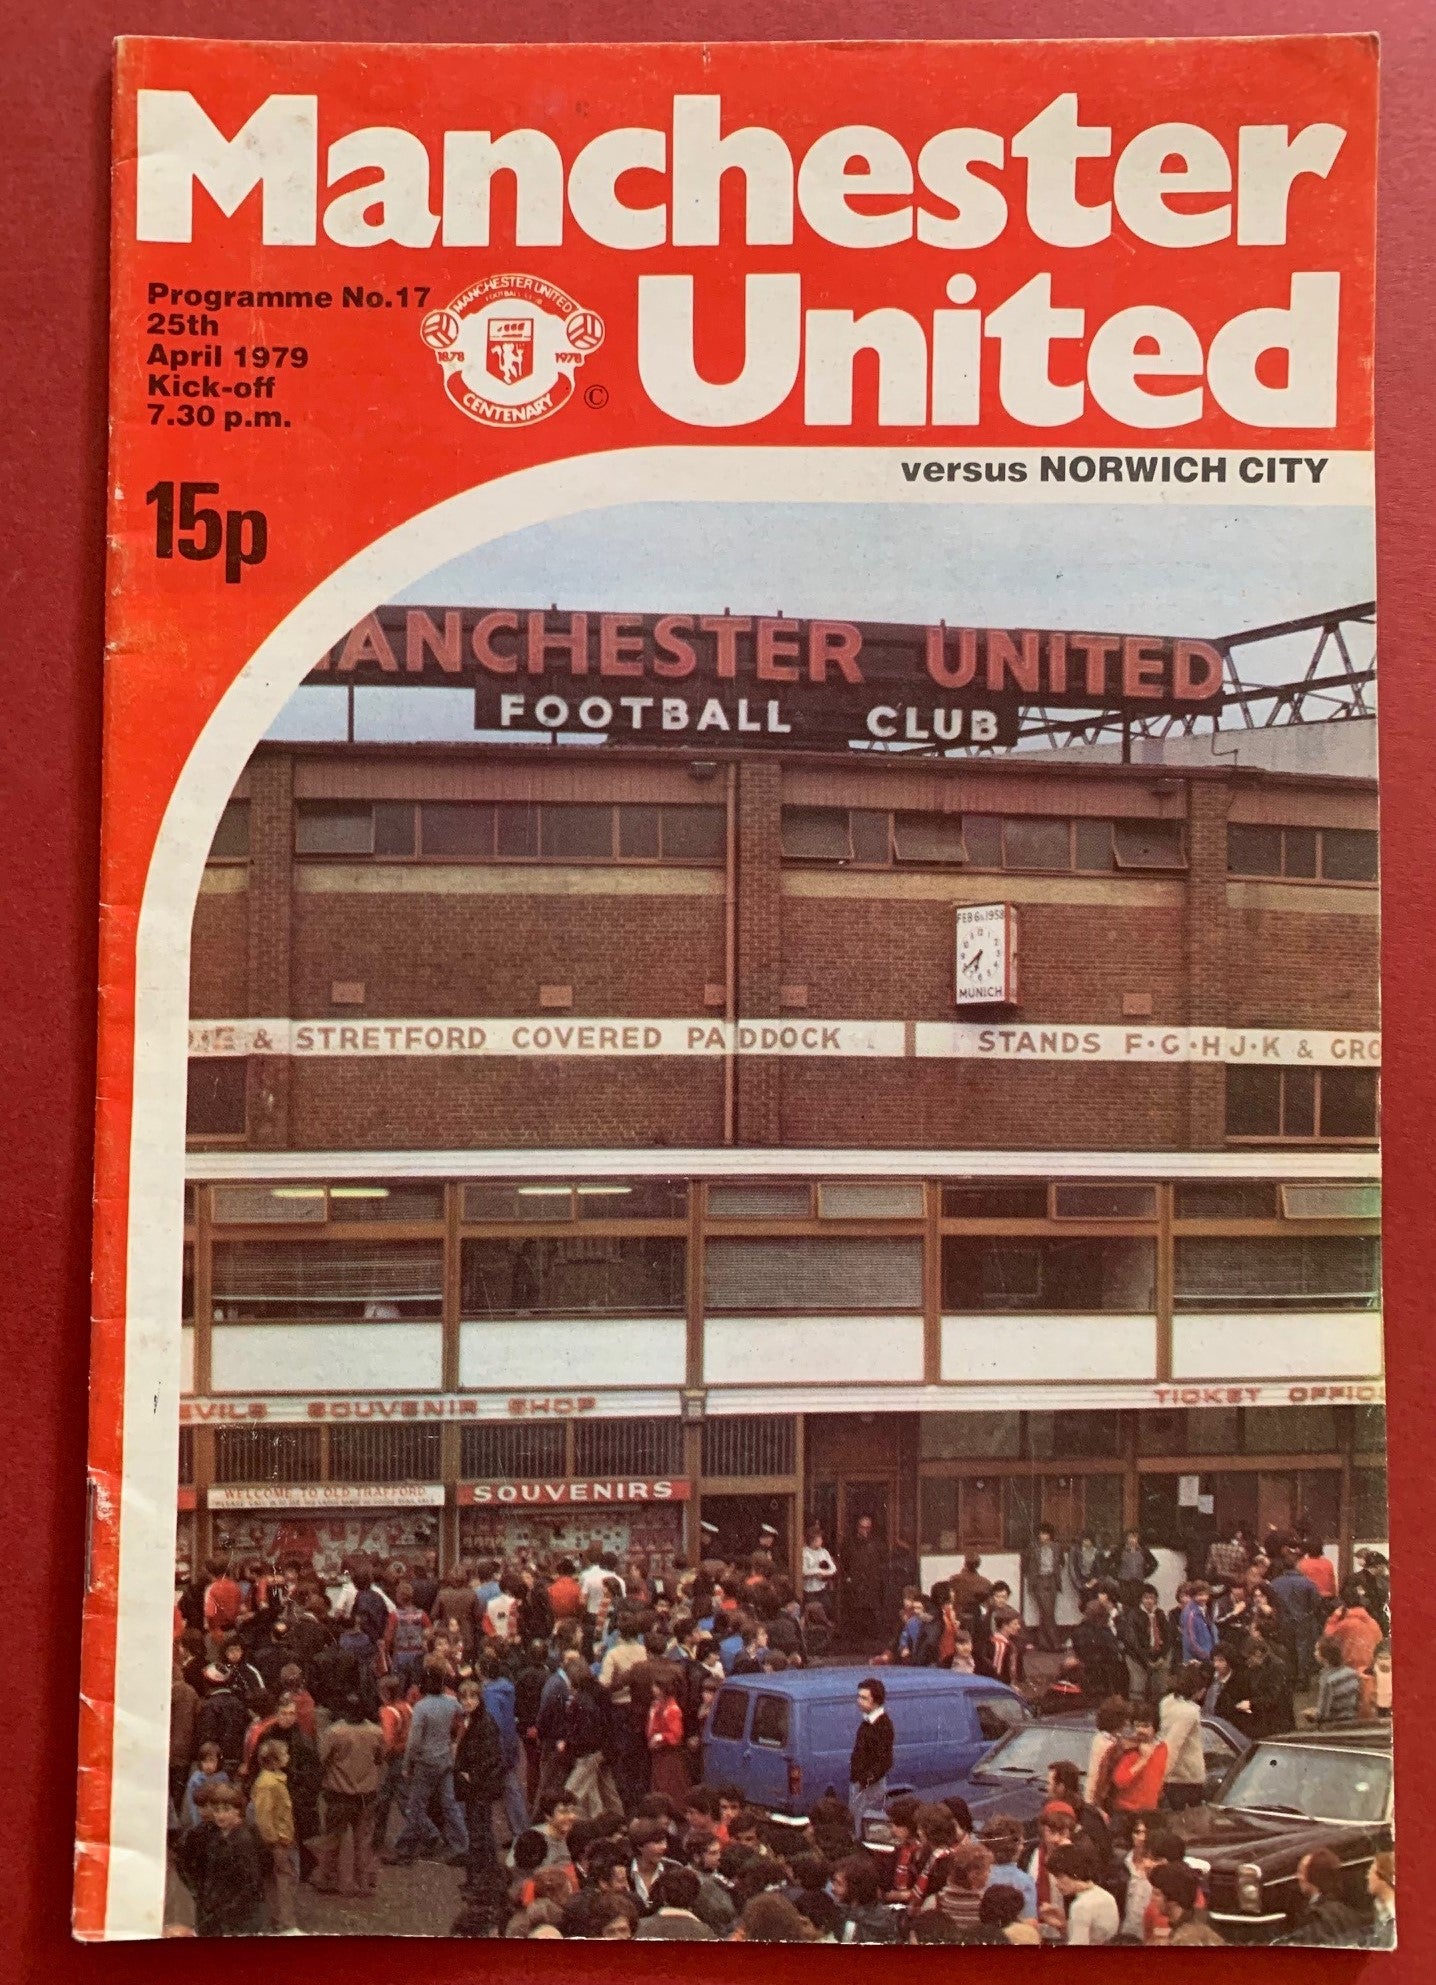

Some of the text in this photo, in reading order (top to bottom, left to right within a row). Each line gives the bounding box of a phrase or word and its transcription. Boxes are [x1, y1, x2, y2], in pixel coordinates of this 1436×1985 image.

[136, 89, 1347, 250] Manchester
[148, 282, 333, 311] Programme
[451, 276, 573, 313] MANCHESTER UNITED
[147, 312, 219, 336] 25th
[146, 343, 309, 371] April 1979
[438, 351, 465, 362] 1878
[555, 352, 582, 363] 1978
[638, 271, 1340, 429] United
[148, 374, 276, 398] Kick-off
[147, 404, 292, 432] 7.30 p.m.
[463, 392, 553, 422] CENTENARY
[901, 456, 1329, 484] versus NORWICH CITY
[146, 481, 267, 584] 15p
[314, 610, 1224, 700] ANCHESTER UNITED
[501, 694, 998, 741] FOOTBALL CLUB
[959, 986, 1002, 998] MUNICH
[252, 1028, 273, 1050] &
[296, 1026, 487, 1050] STRETFORD
[511, 1026, 662, 1050] COVERED
[687, 1026, 841, 1050] PADDOCK
[979, 1031, 1101, 1054] STANDS
[1296, 1039, 1314, 1059] &
[307, 1399, 477, 1419] SOUVENIR
[508, 1396, 596, 1415] SHOP
[1153, 1385, 1385, 1404] TICKET OFFIC
[324, 1487, 350, 1498] OLD
[473, 1481, 673, 1503] SOUVENIRS
